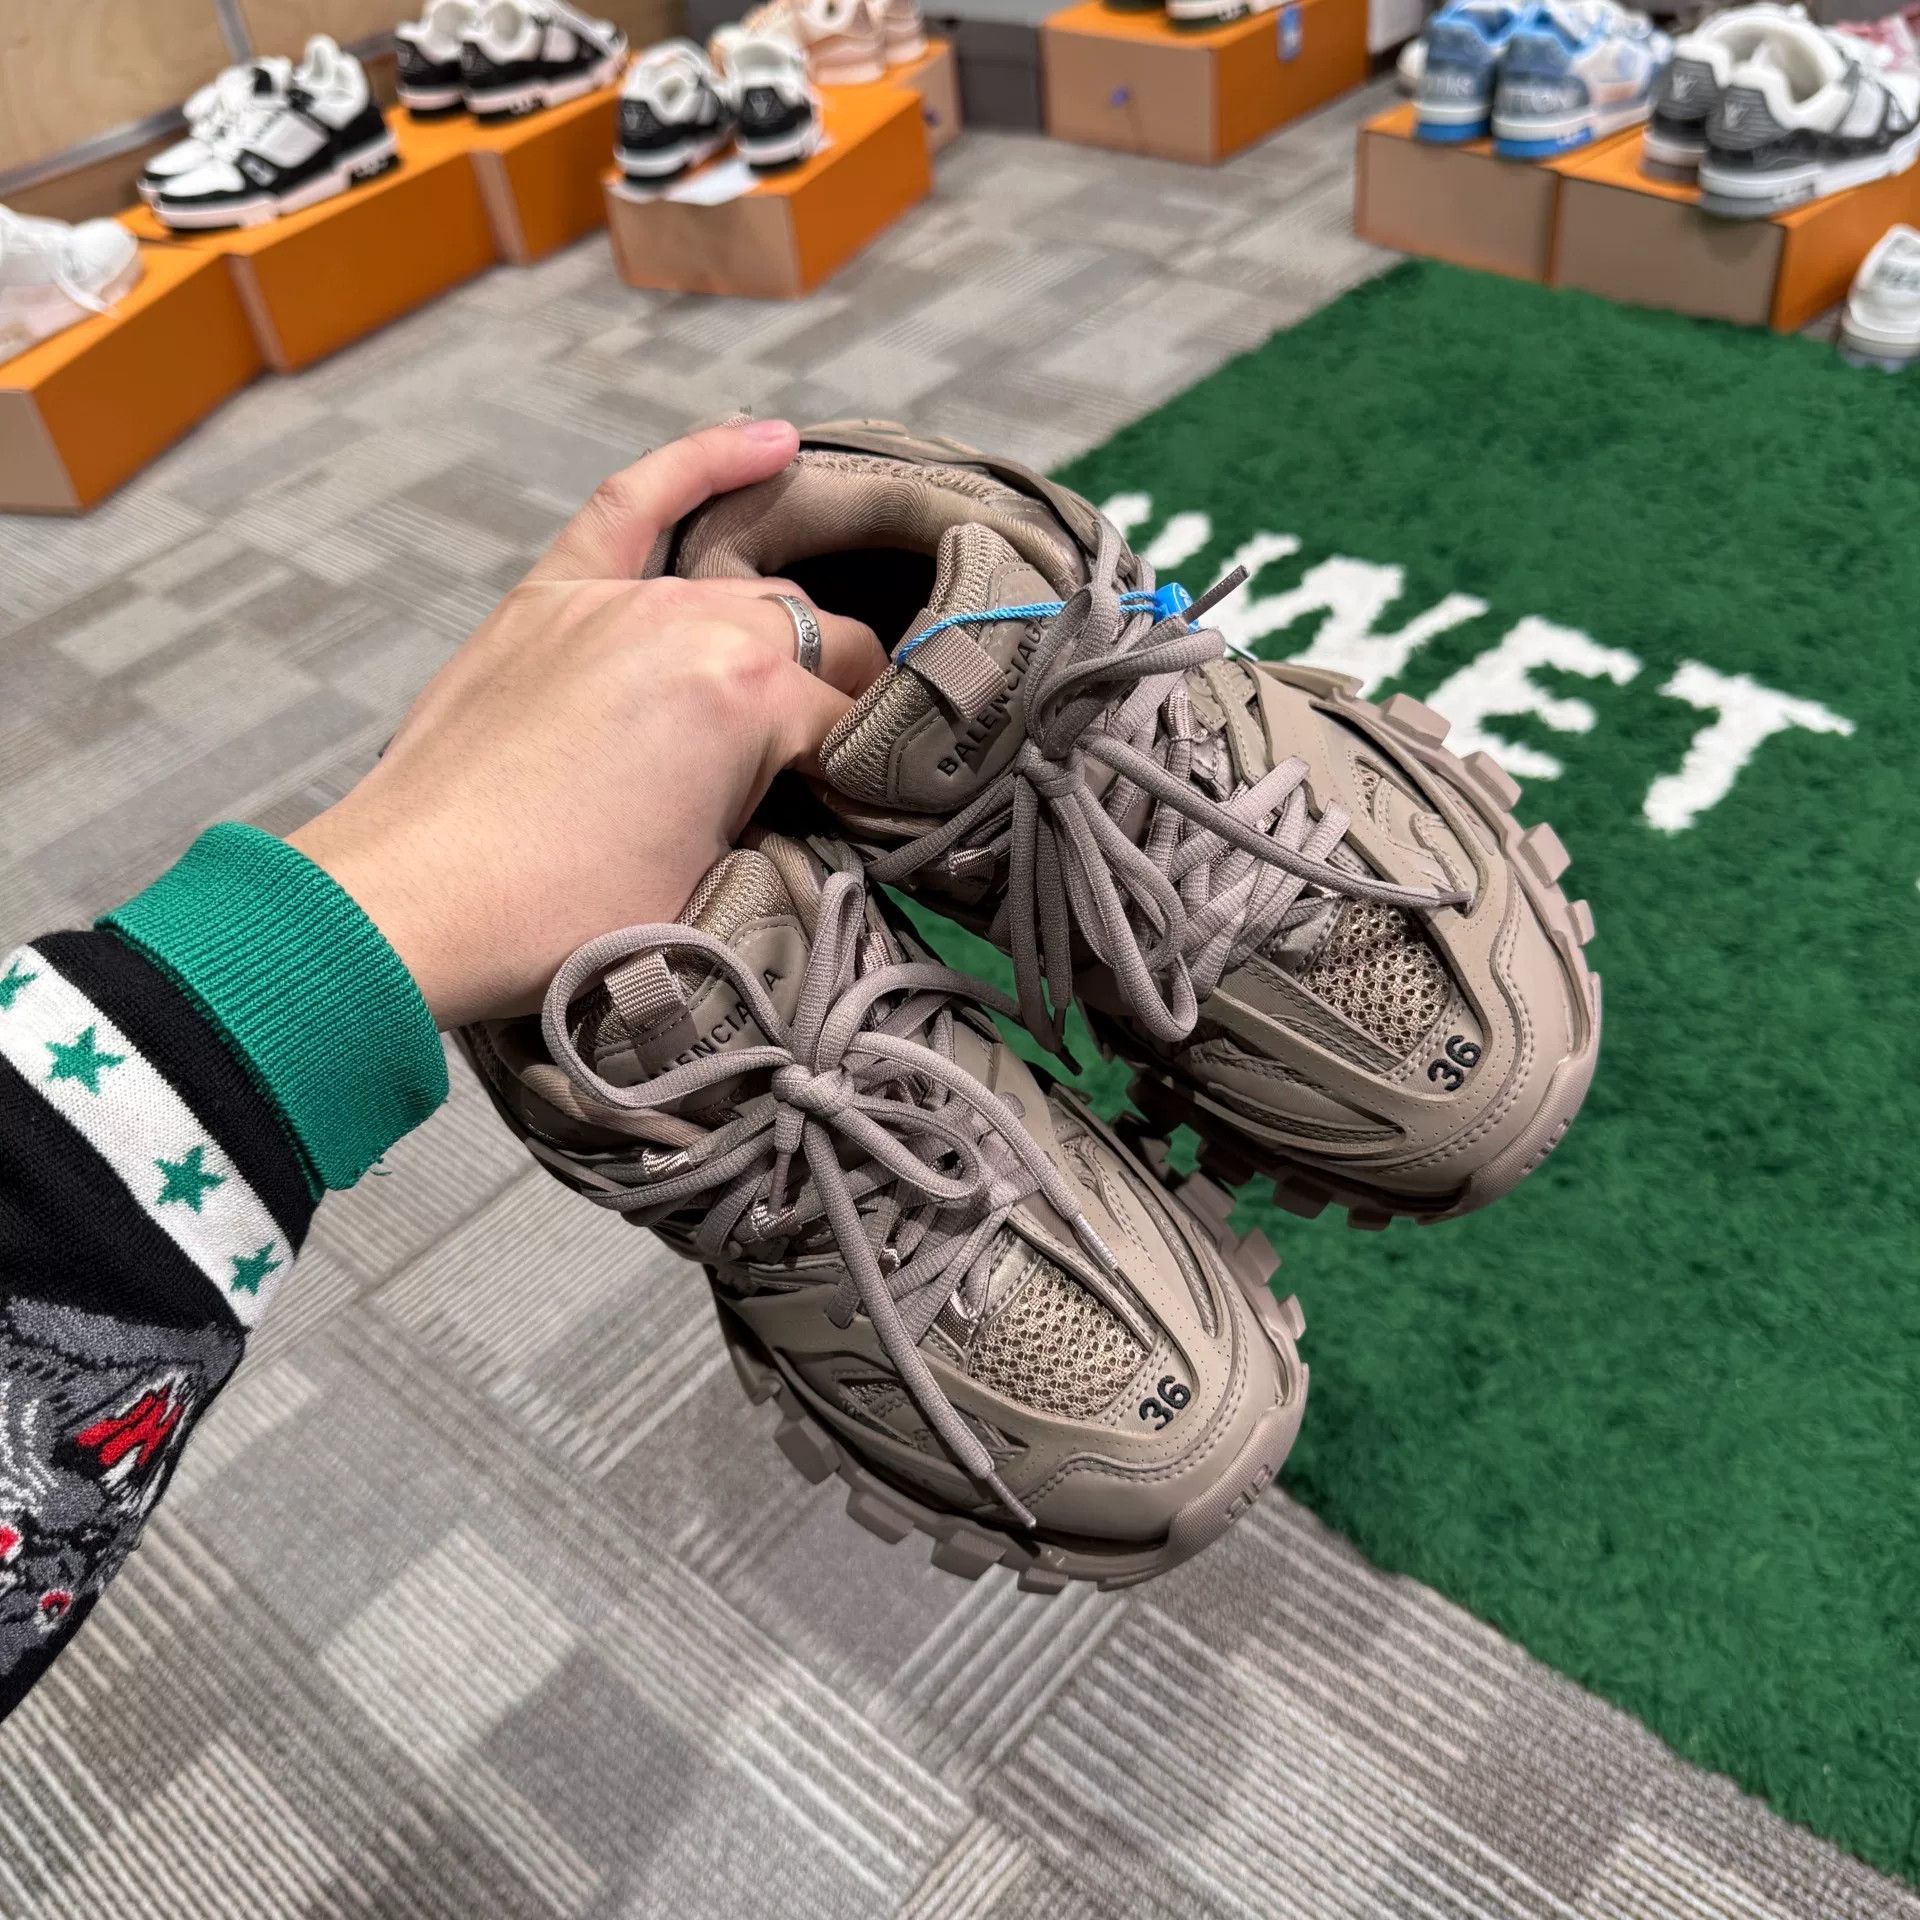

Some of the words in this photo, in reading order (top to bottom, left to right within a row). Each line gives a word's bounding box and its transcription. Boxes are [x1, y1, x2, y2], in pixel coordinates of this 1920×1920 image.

[937, 616, 1045, 777] BALENCIAG
[1427, 1034, 1482, 1092] 36
[1138, 1375, 1192, 1431] 36
